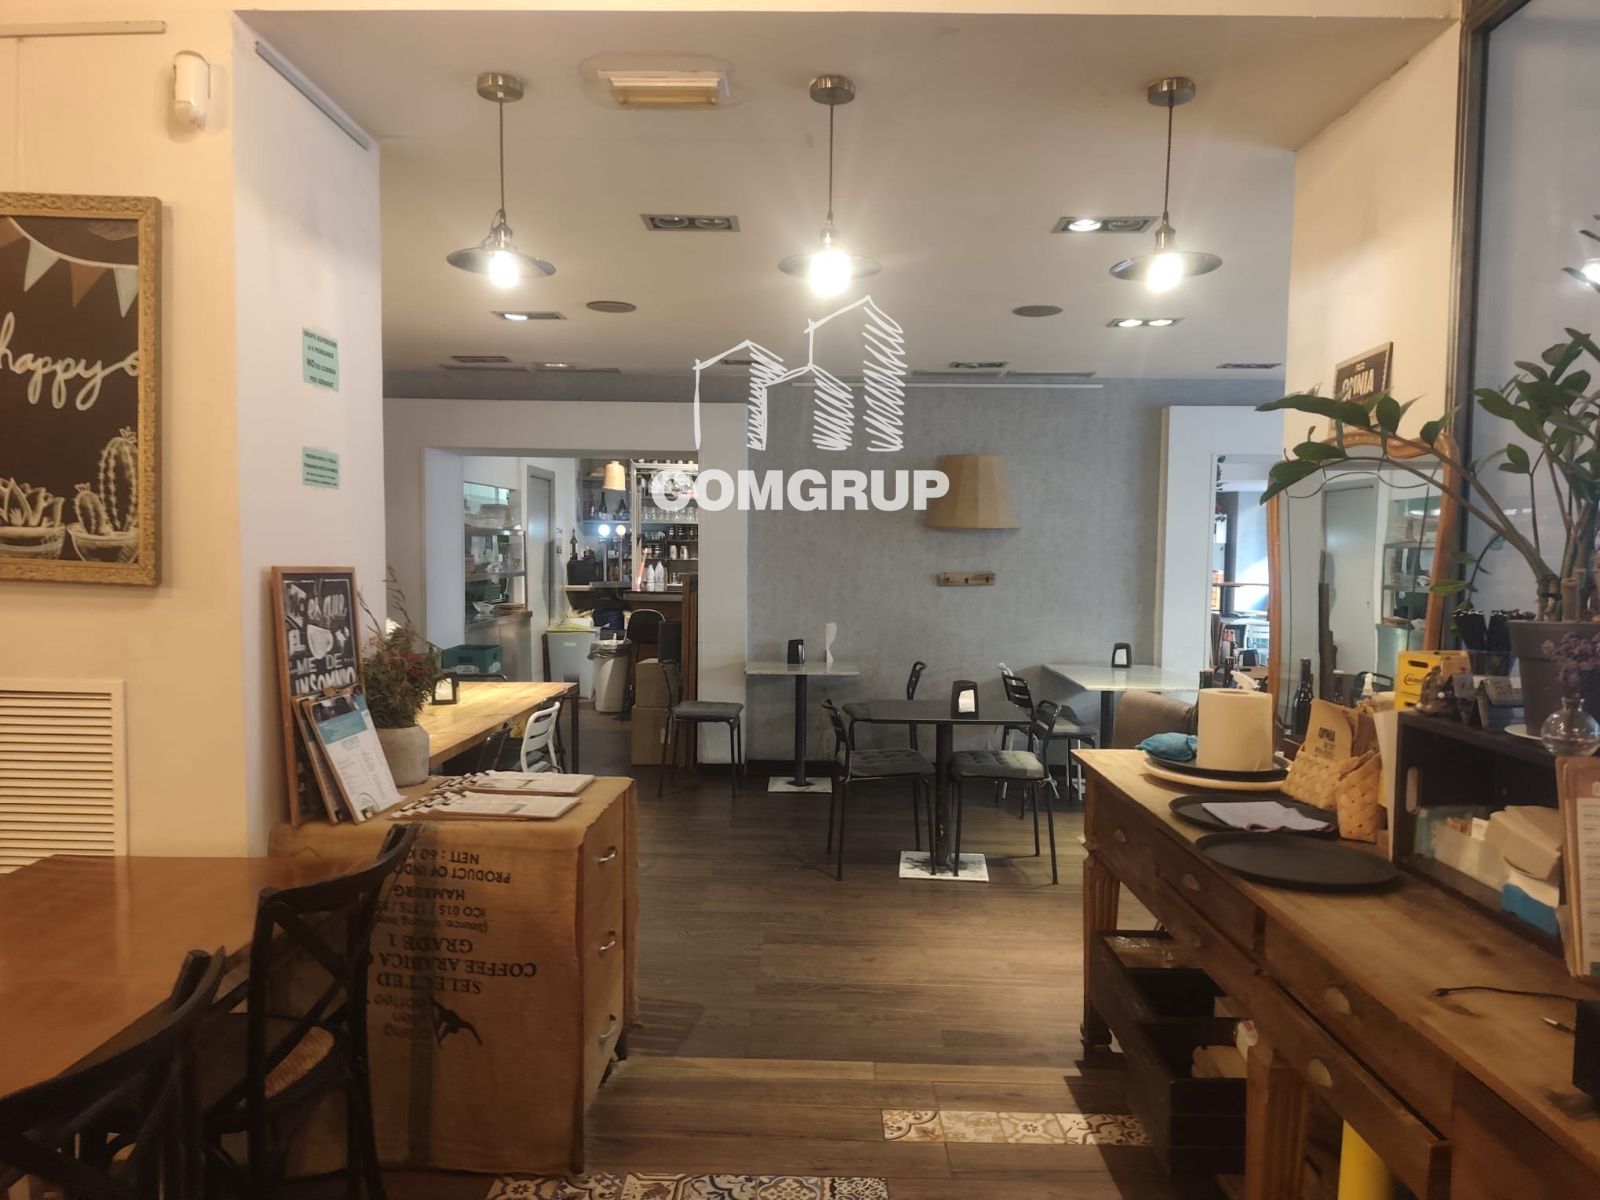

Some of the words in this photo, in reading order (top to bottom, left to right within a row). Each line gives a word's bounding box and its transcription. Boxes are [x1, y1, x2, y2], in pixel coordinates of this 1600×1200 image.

[0, 311, 105, 411] happy
[449, 850, 480, 865] NETT
[430, 865, 448, 878] OF
[450, 866, 511, 884] PRODUCT
[393, 884, 465, 900] HAMBURG
[389, 933, 397, 947] 1
[401, 935, 474, 953] GRADE
[378, 952, 461, 972] ARABICA
[465, 958, 537, 978] COFFEE
[376, 972, 484, 995] SELECTED
